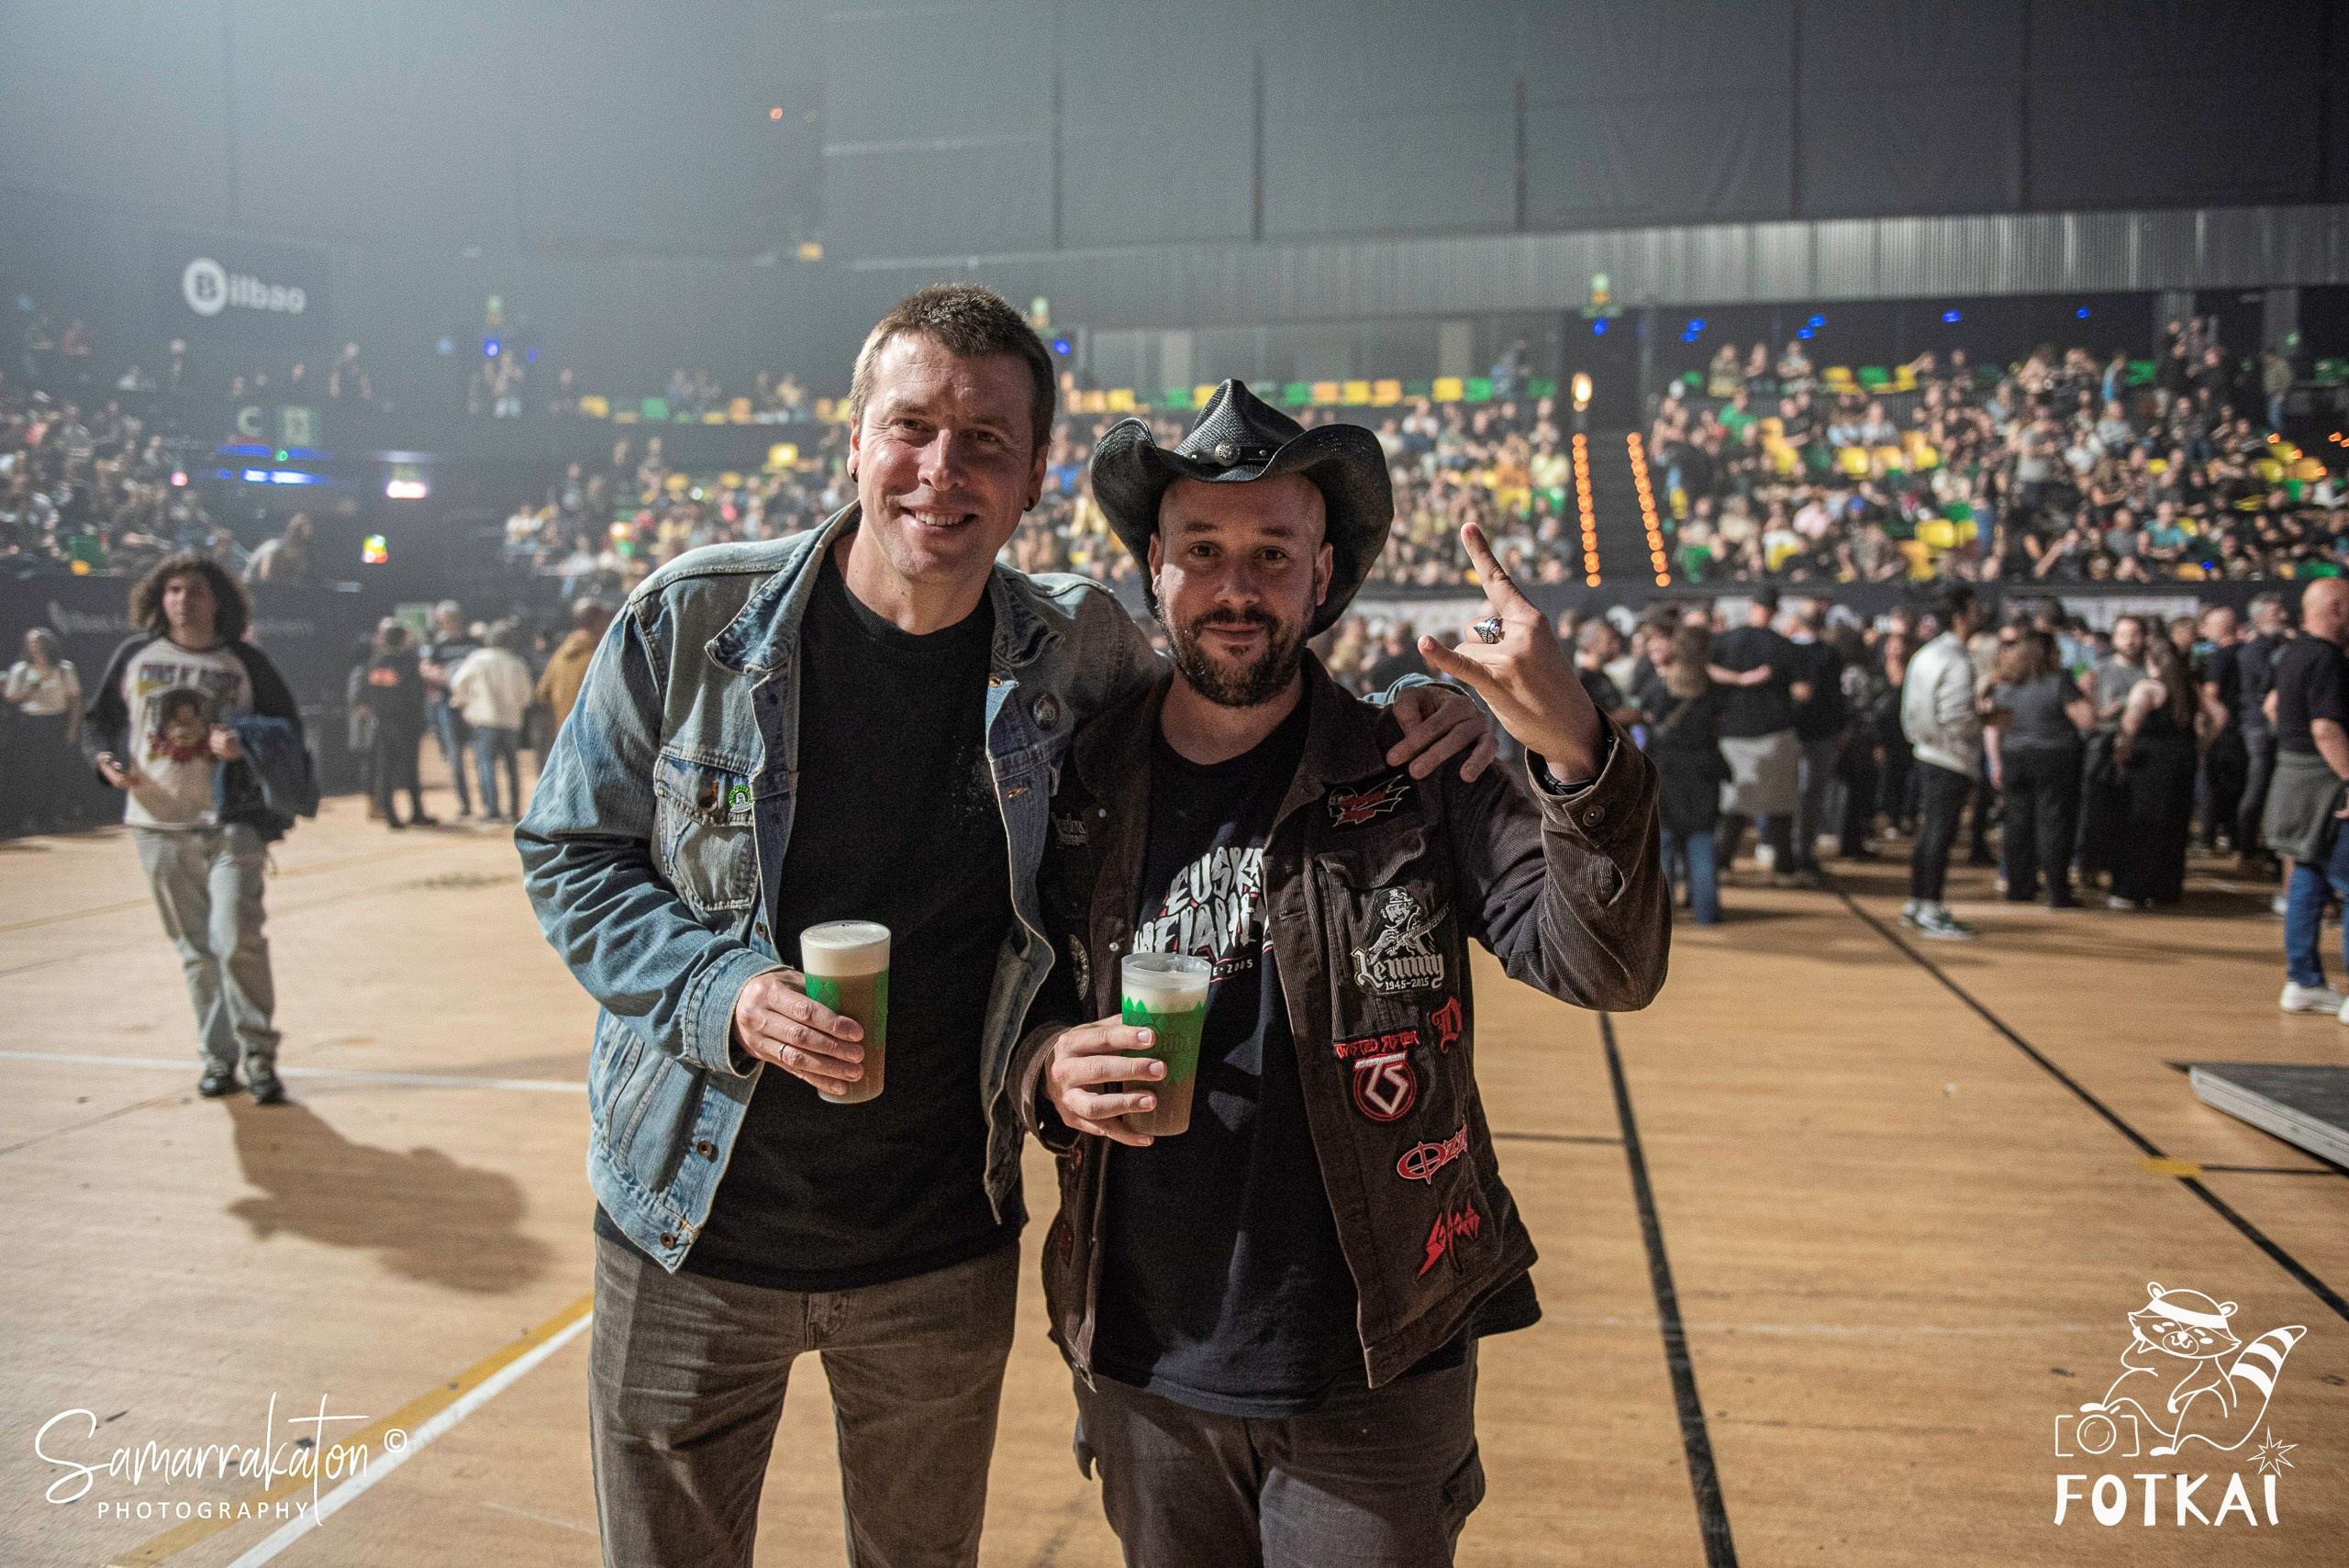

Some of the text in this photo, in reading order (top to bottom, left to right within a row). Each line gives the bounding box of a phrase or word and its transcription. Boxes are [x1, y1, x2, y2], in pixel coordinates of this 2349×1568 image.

[1227, 959, 1253, 973] 2005
[1386, 977, 1430, 991] 1945-2015
[1333, 1030, 1420, 1059] TWISTED SISTER
